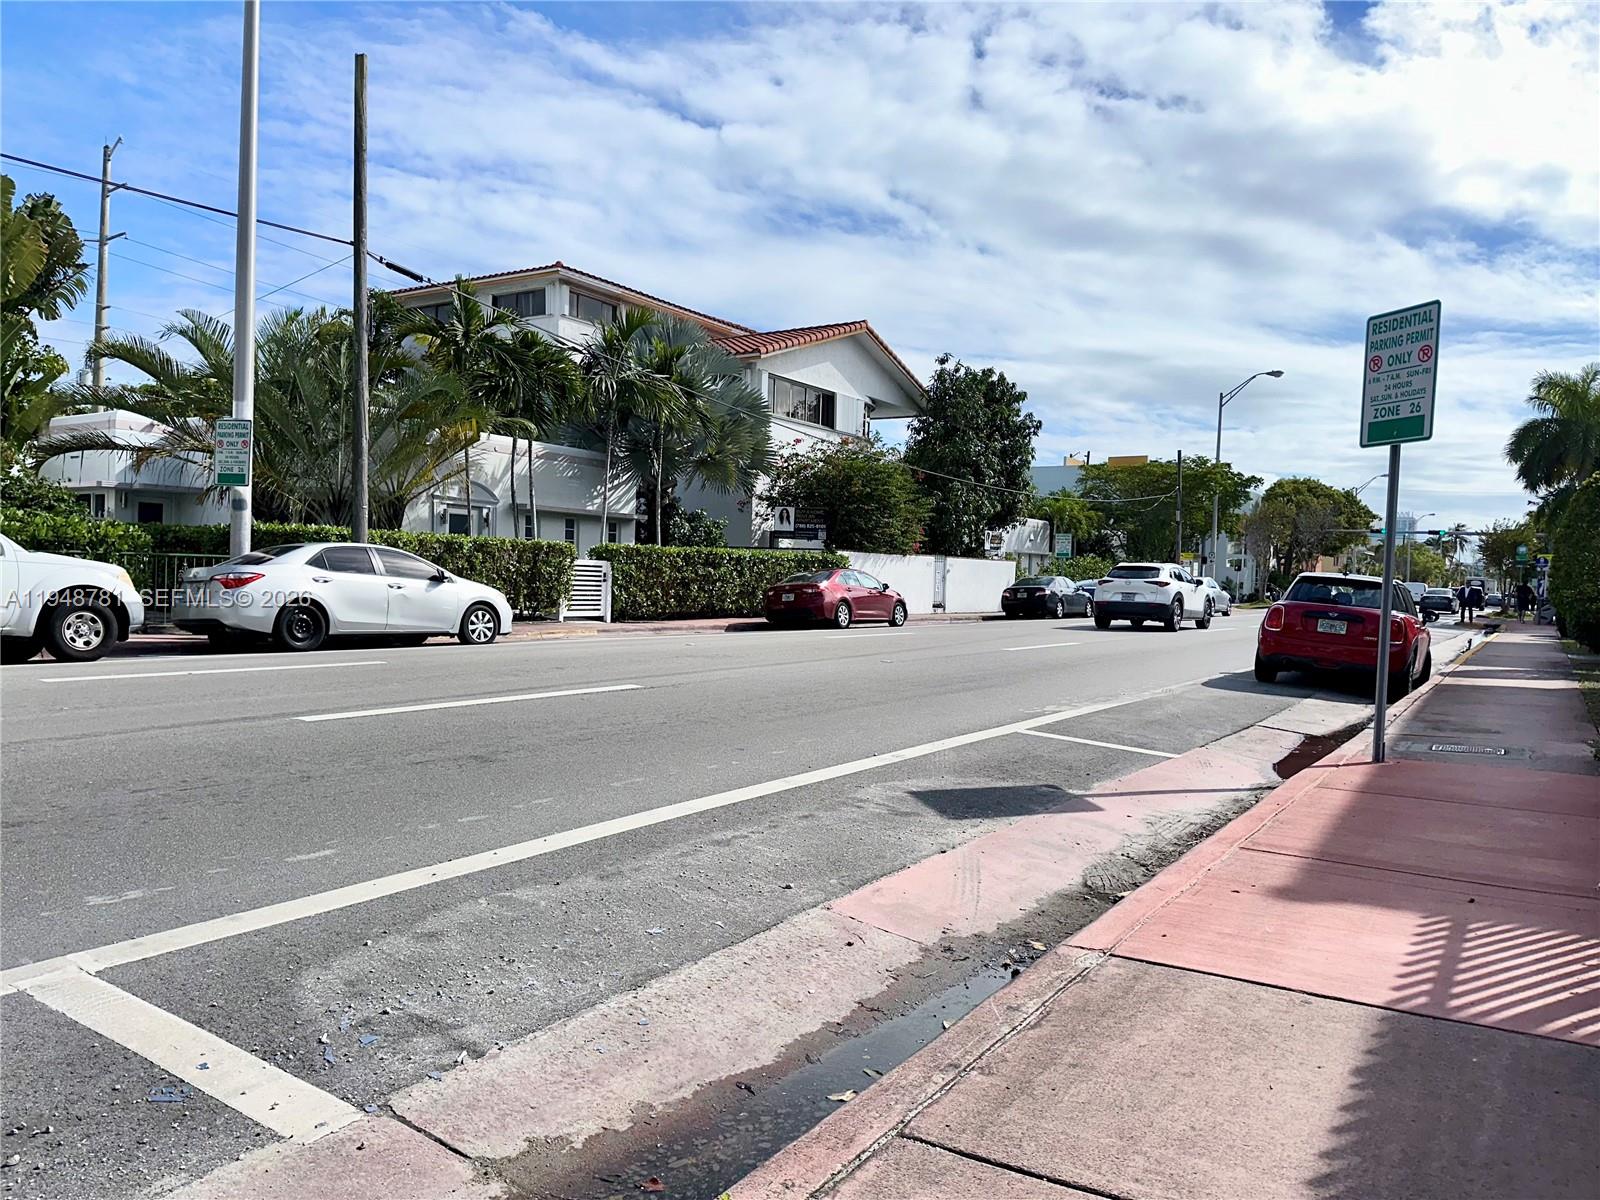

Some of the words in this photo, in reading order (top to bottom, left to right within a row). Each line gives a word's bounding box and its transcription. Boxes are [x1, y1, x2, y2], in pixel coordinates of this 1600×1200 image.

[1371, 309, 1434, 337] RESIDENTIAL
[1369, 334, 1404, 353] PARKING
[1405, 327, 1434, 345] PERMIT
[1387, 350, 1413, 367] ONLY
[1384, 383, 1391, 392] 24
[1392, 380, 1413, 391] HOURS
[1400, 387, 1427, 398] HOLIDAYS
[1373, 404, 1401, 419] ZONE
[1409, 402, 1422, 414] 26
[218, 422, 249, 430] RESIDENTIAL
[217, 431, 234, 439] PARKING
[235, 431, 249, 439] PERMIT
[226, 440, 239, 448] ONLY
